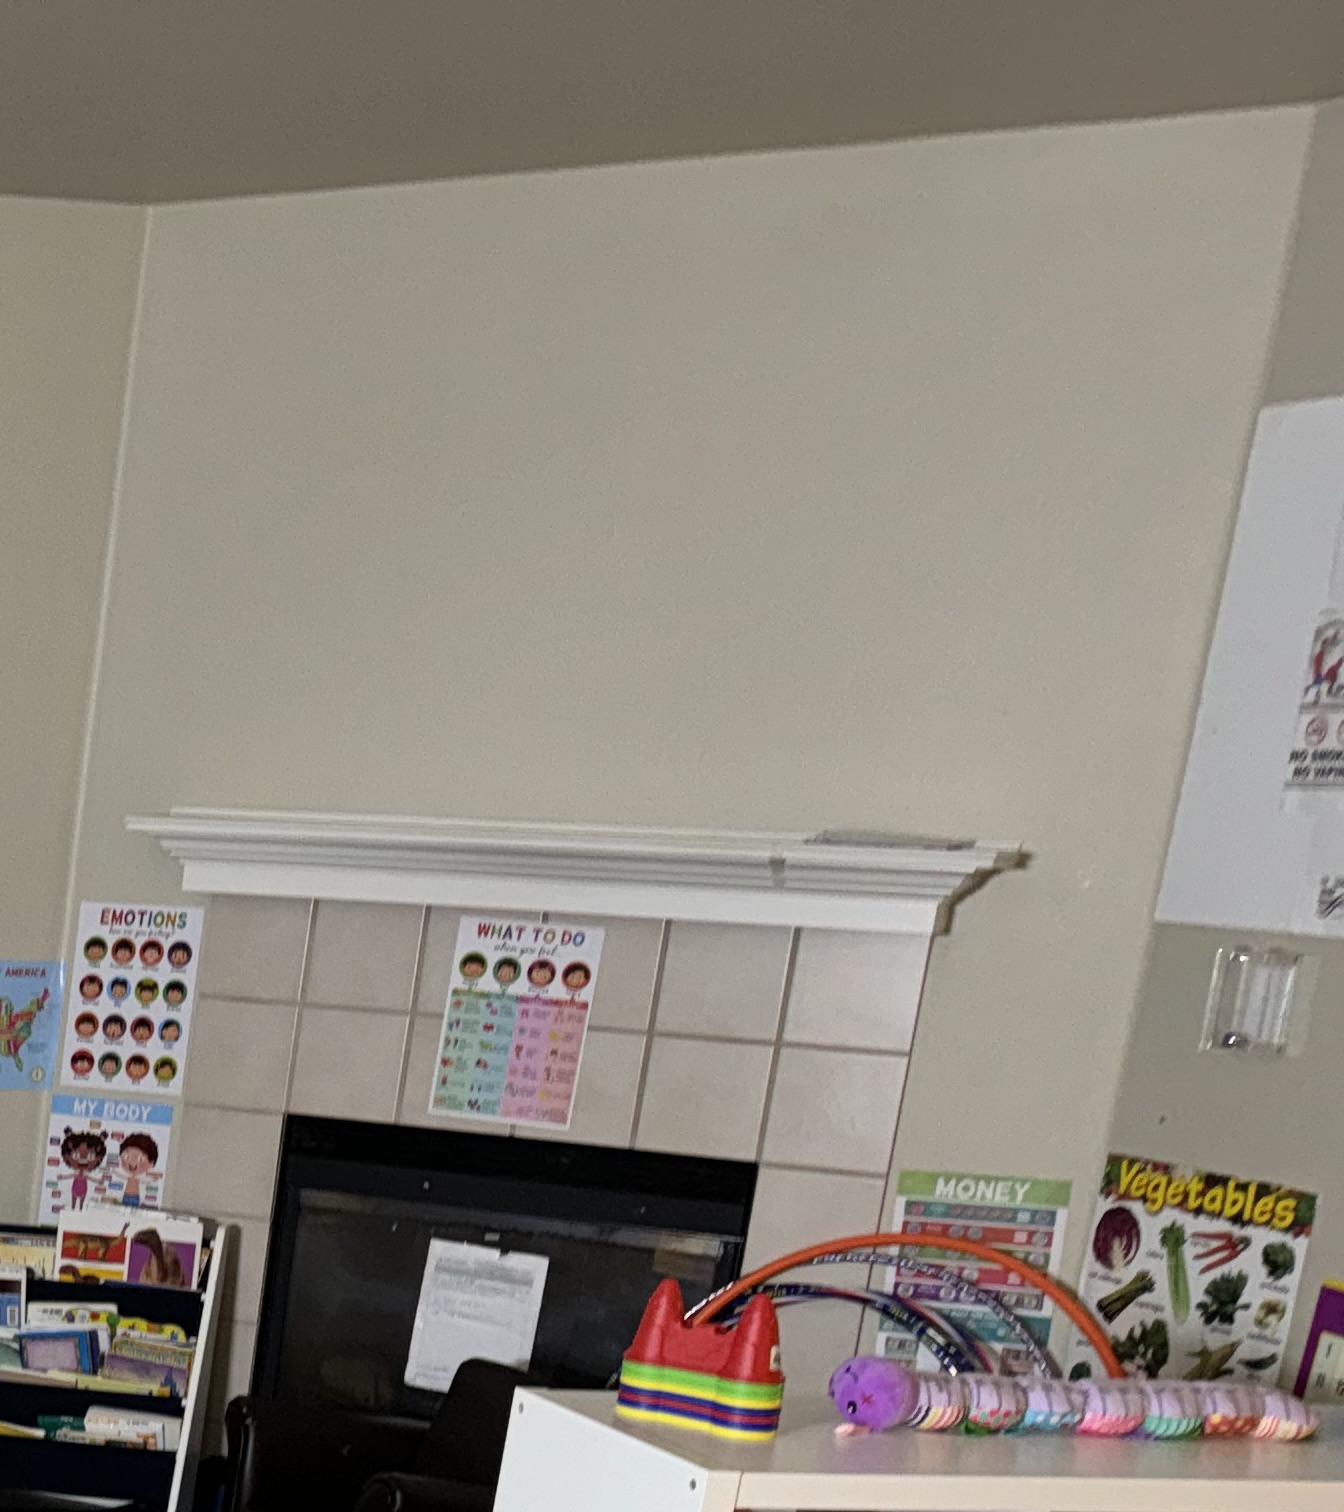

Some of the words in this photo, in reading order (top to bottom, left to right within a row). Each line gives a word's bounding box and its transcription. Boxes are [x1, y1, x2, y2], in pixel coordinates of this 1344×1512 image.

[100, 907, 187, 929] EMOTIONS
[477, 922, 526, 942] WHAT
[533, 927, 556, 944] TO
[561, 931, 586, 947] DO
[5, 967, 47, 978] AMERICA
[73, 1098, 98, 1115] MY
[103, 1102, 152, 1121] BODY
[934, 1176, 1032, 1204] MONEY
[1118, 1158, 1298, 1229] Vegetables
